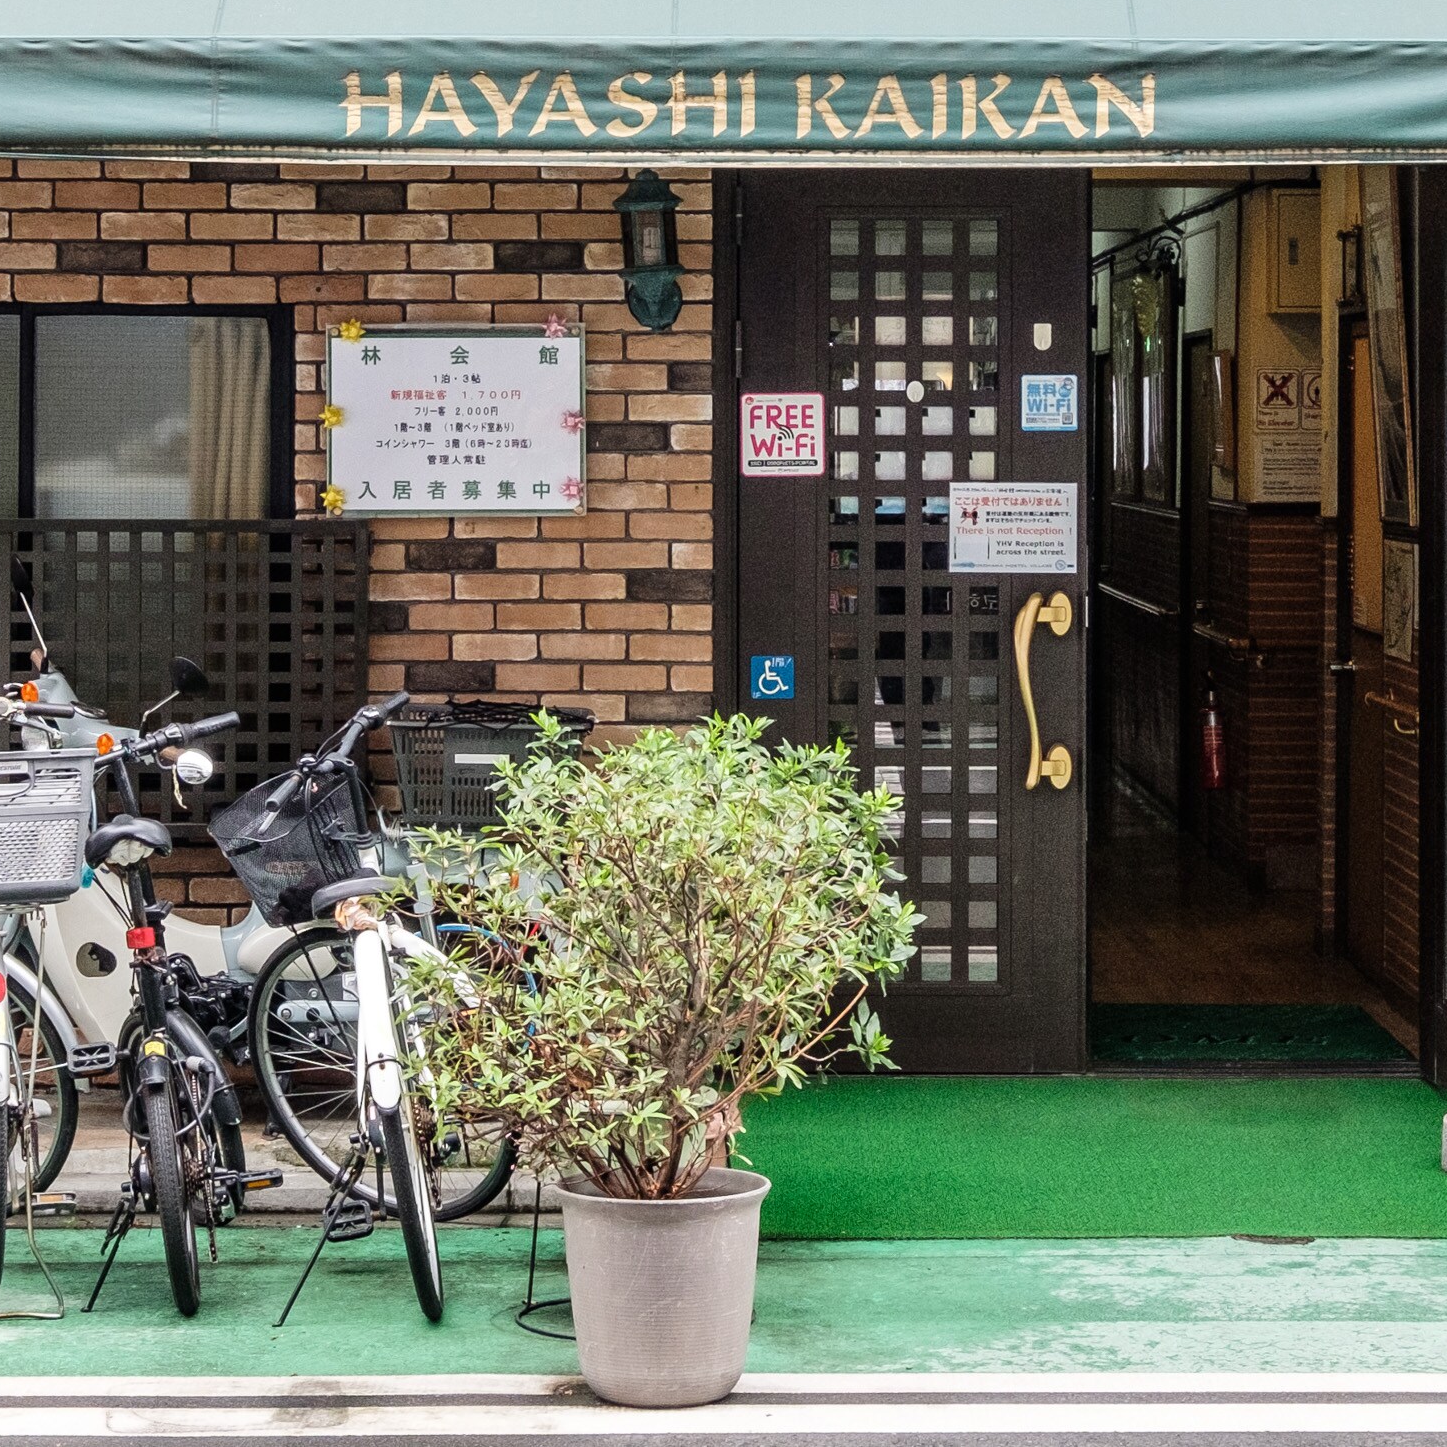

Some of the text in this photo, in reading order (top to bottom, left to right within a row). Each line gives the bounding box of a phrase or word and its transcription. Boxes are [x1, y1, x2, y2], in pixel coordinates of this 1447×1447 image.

[338, 68, 1156, 140] HAYASHI KAIKAN
[360, 345, 560, 366] 林会館
[390, 389, 447, 400] 新規福祉客
[1027, 382, 1057, 397] 無料
[414, 406, 446, 417] フリー客
[1027, 398, 1071, 413] Wi-Fi
[750, 405, 815, 429] FREE
[750, 433, 815, 458] Wi-Fi
[427, 455, 486, 465] 管理人常駐
[357, 480, 551, 500] 入居者募集中
[956, 527, 984, 535] There
[997, 527, 1014, 535] not
[1016, 527, 1064, 536] Reception
[1015, 540, 1055, 548] Reception
